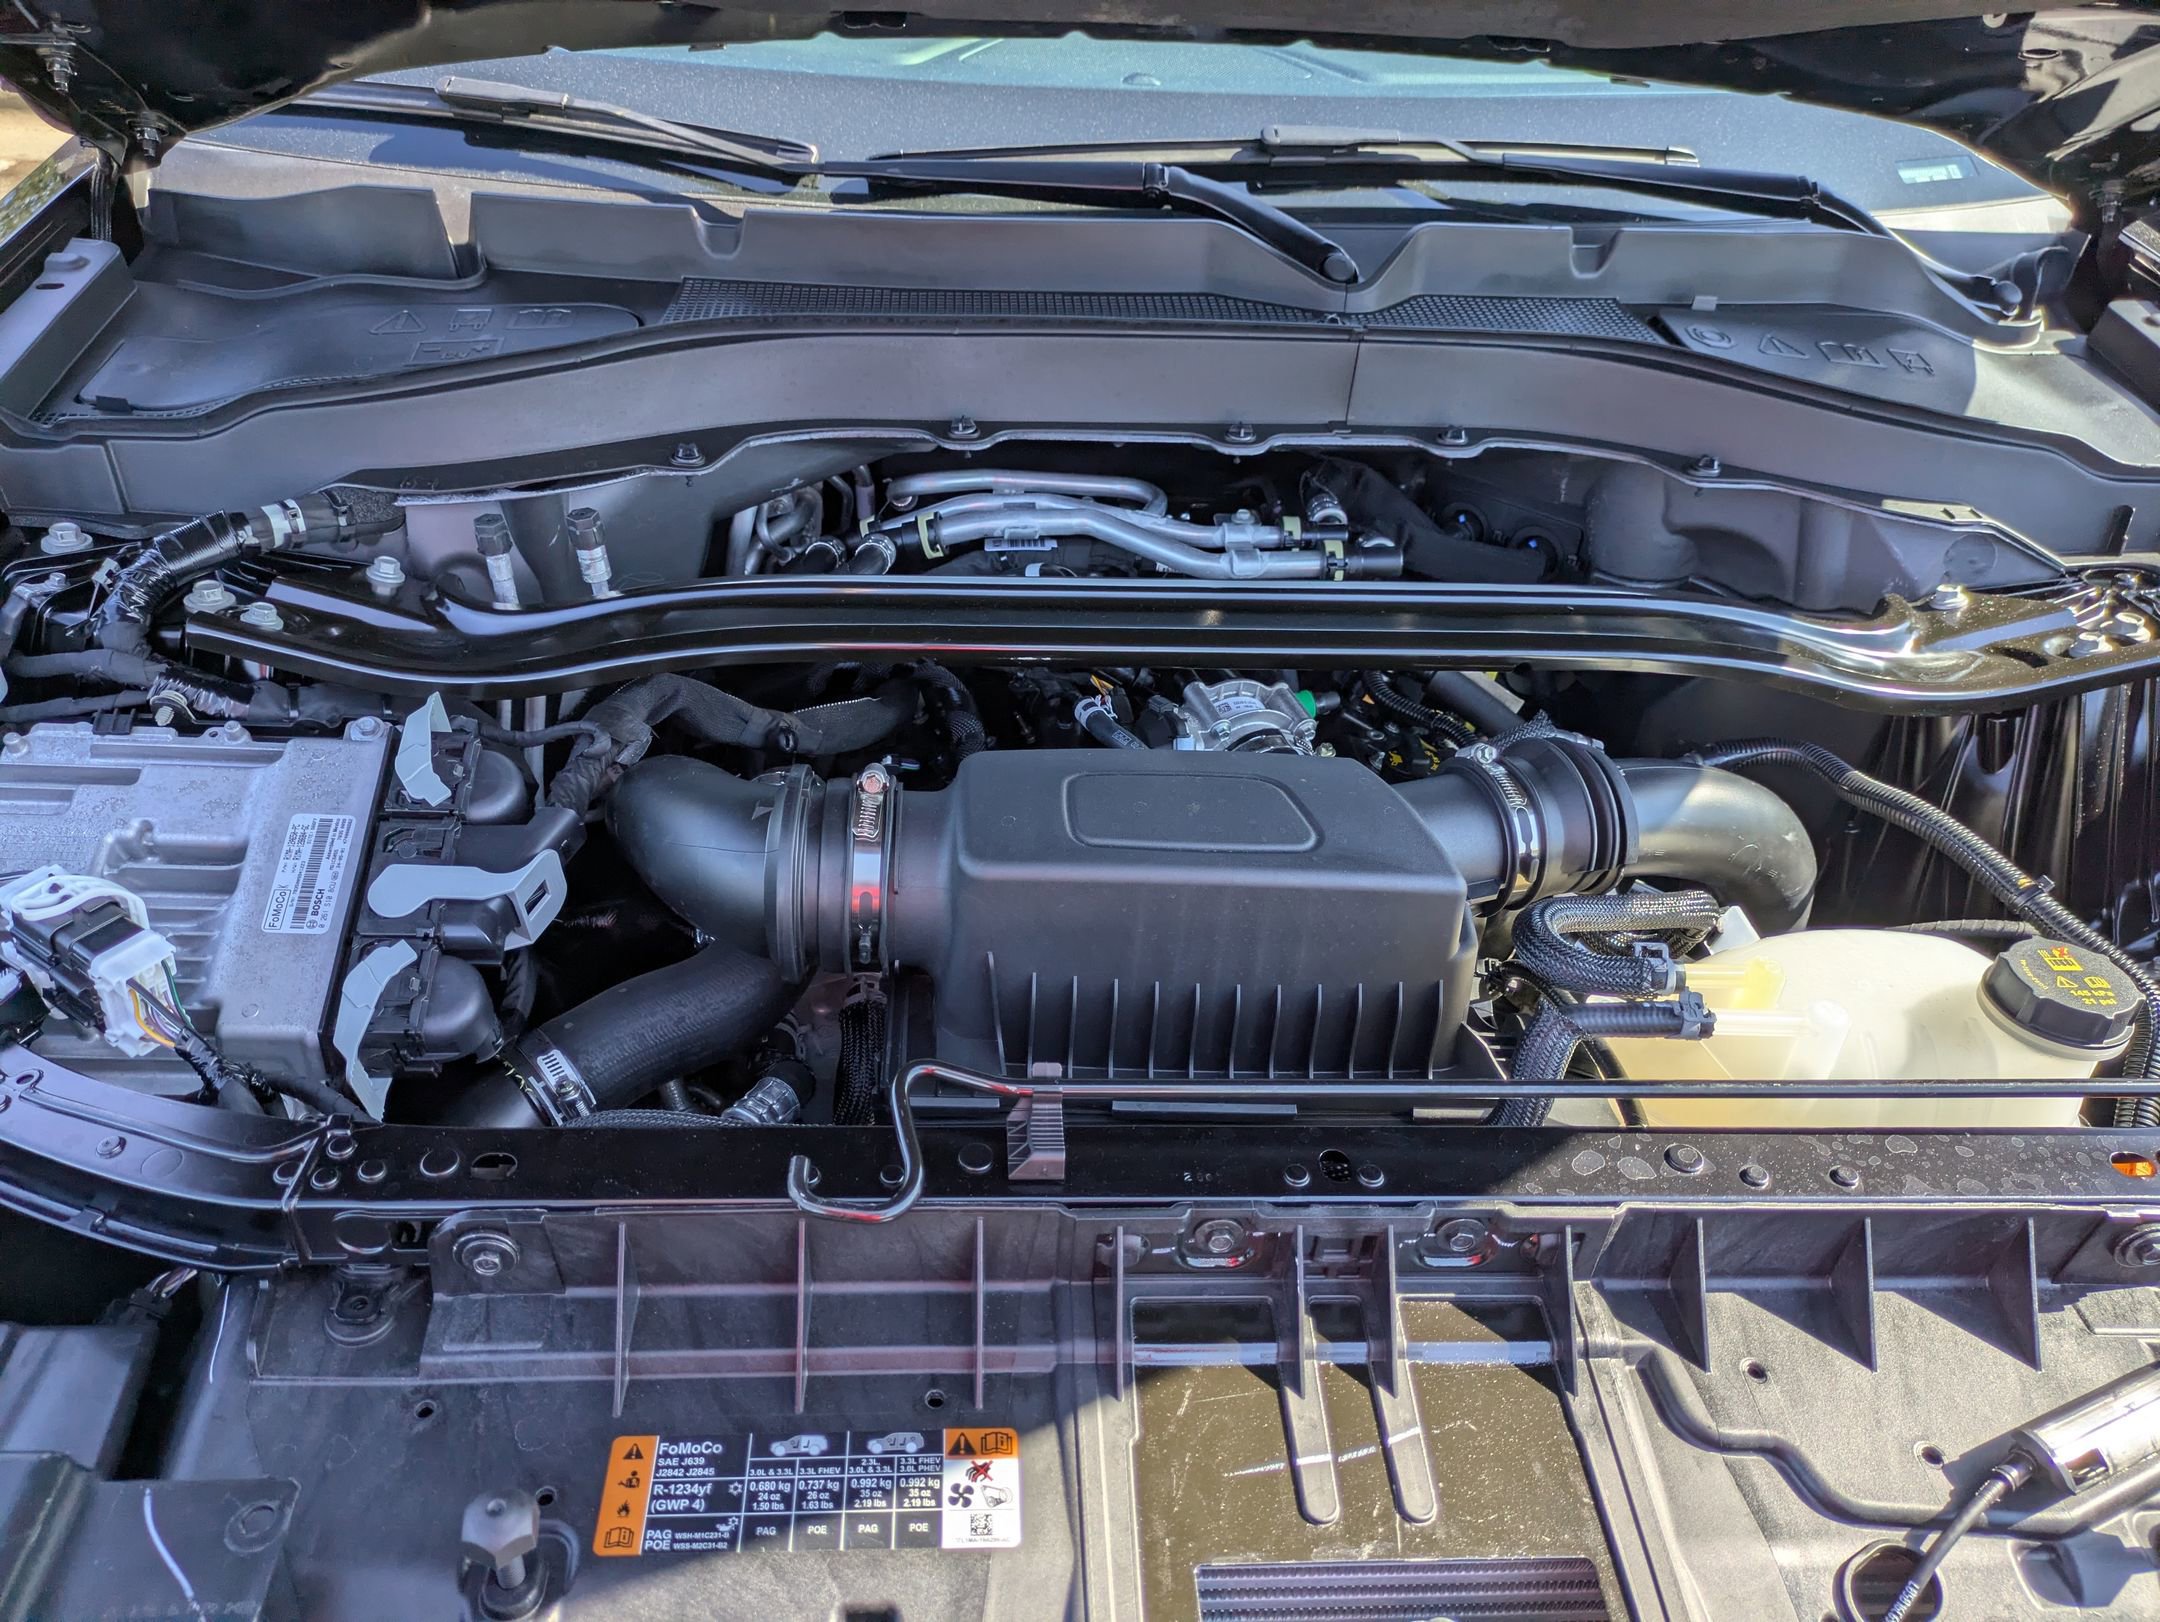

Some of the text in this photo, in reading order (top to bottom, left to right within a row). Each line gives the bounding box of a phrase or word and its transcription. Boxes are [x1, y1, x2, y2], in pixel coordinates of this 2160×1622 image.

[326, 838, 336, 860] Assembled
[333, 819, 341, 832] Mexico
[311, 889, 325, 916] BOSCH
[268, 891, 287, 928] FoMoCo
[321, 911, 329, 921] 261
[659, 1442, 723, 1455] FoMoCo
[657, 1457, 705, 1466] SAE J639
[656, 1468, 715, 1477] J2842 J2845
[750, 1481, 790, 1492] 0.680 kg
[799, 1480, 839, 1491] 0.737 kg
[851, 1478, 892, 1489] 0.992 kg
[900, 1478, 940, 1488] 0.992 kg
[654, 1483, 712, 1494] R-1234yf
[909, 1489, 918, 1497] 35
[651, 1499, 705, 1512] (GWP 4)
[753, 1502, 784, 1510] 1.50 lbs
[821, 1501, 833, 1509] lbs
[854, 1499, 886, 1507] 2.19 lbs
[923, 1498, 935, 1506] lbs
[756, 1527, 776, 1535] PAG
[808, 1526, 827, 1534] POE
[859, 1525, 878, 1533] PAG
[909, 1523, 928, 1532] POE
[647, 1530, 671, 1539] PAG
[644, 1540, 670, 1550] POE
